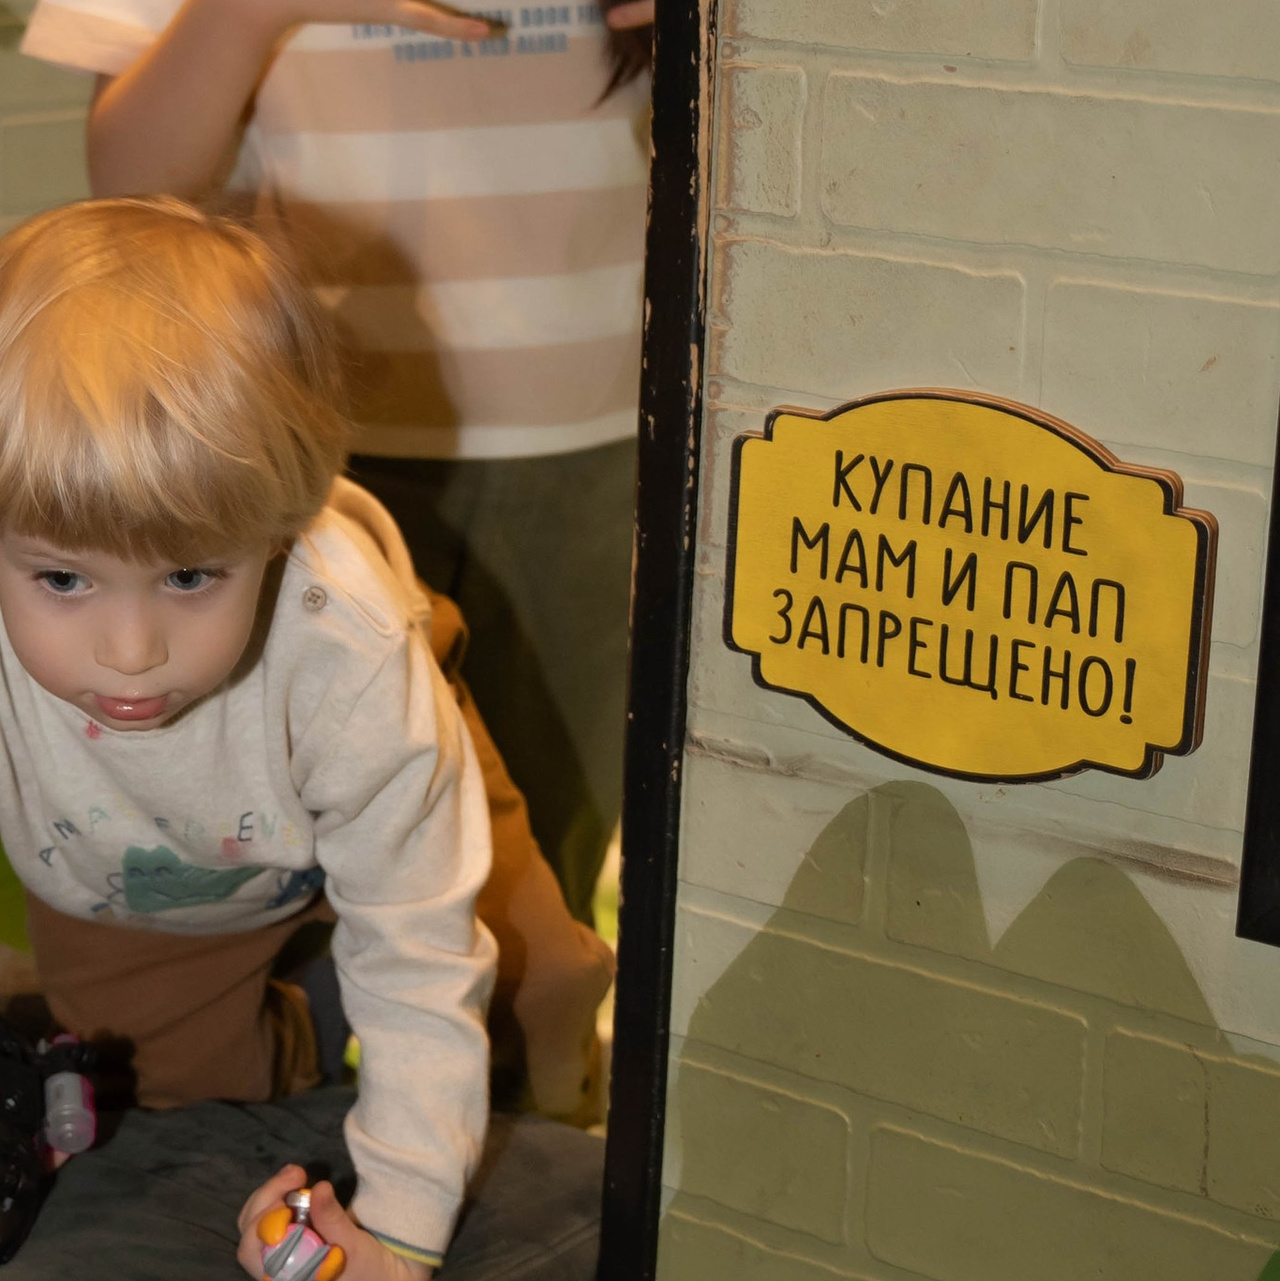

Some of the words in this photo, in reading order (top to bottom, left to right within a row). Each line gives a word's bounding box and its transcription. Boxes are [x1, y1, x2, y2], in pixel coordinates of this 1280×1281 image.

[831, 449, 1091, 557] КУПАНИЕ
[790, 516, 918, 599] МАМ
[941, 547, 979, 613] И
[1002, 561, 1127, 645] ПАП
[768, 588, 1138, 726] ЗАПРЕЩЕНО!
